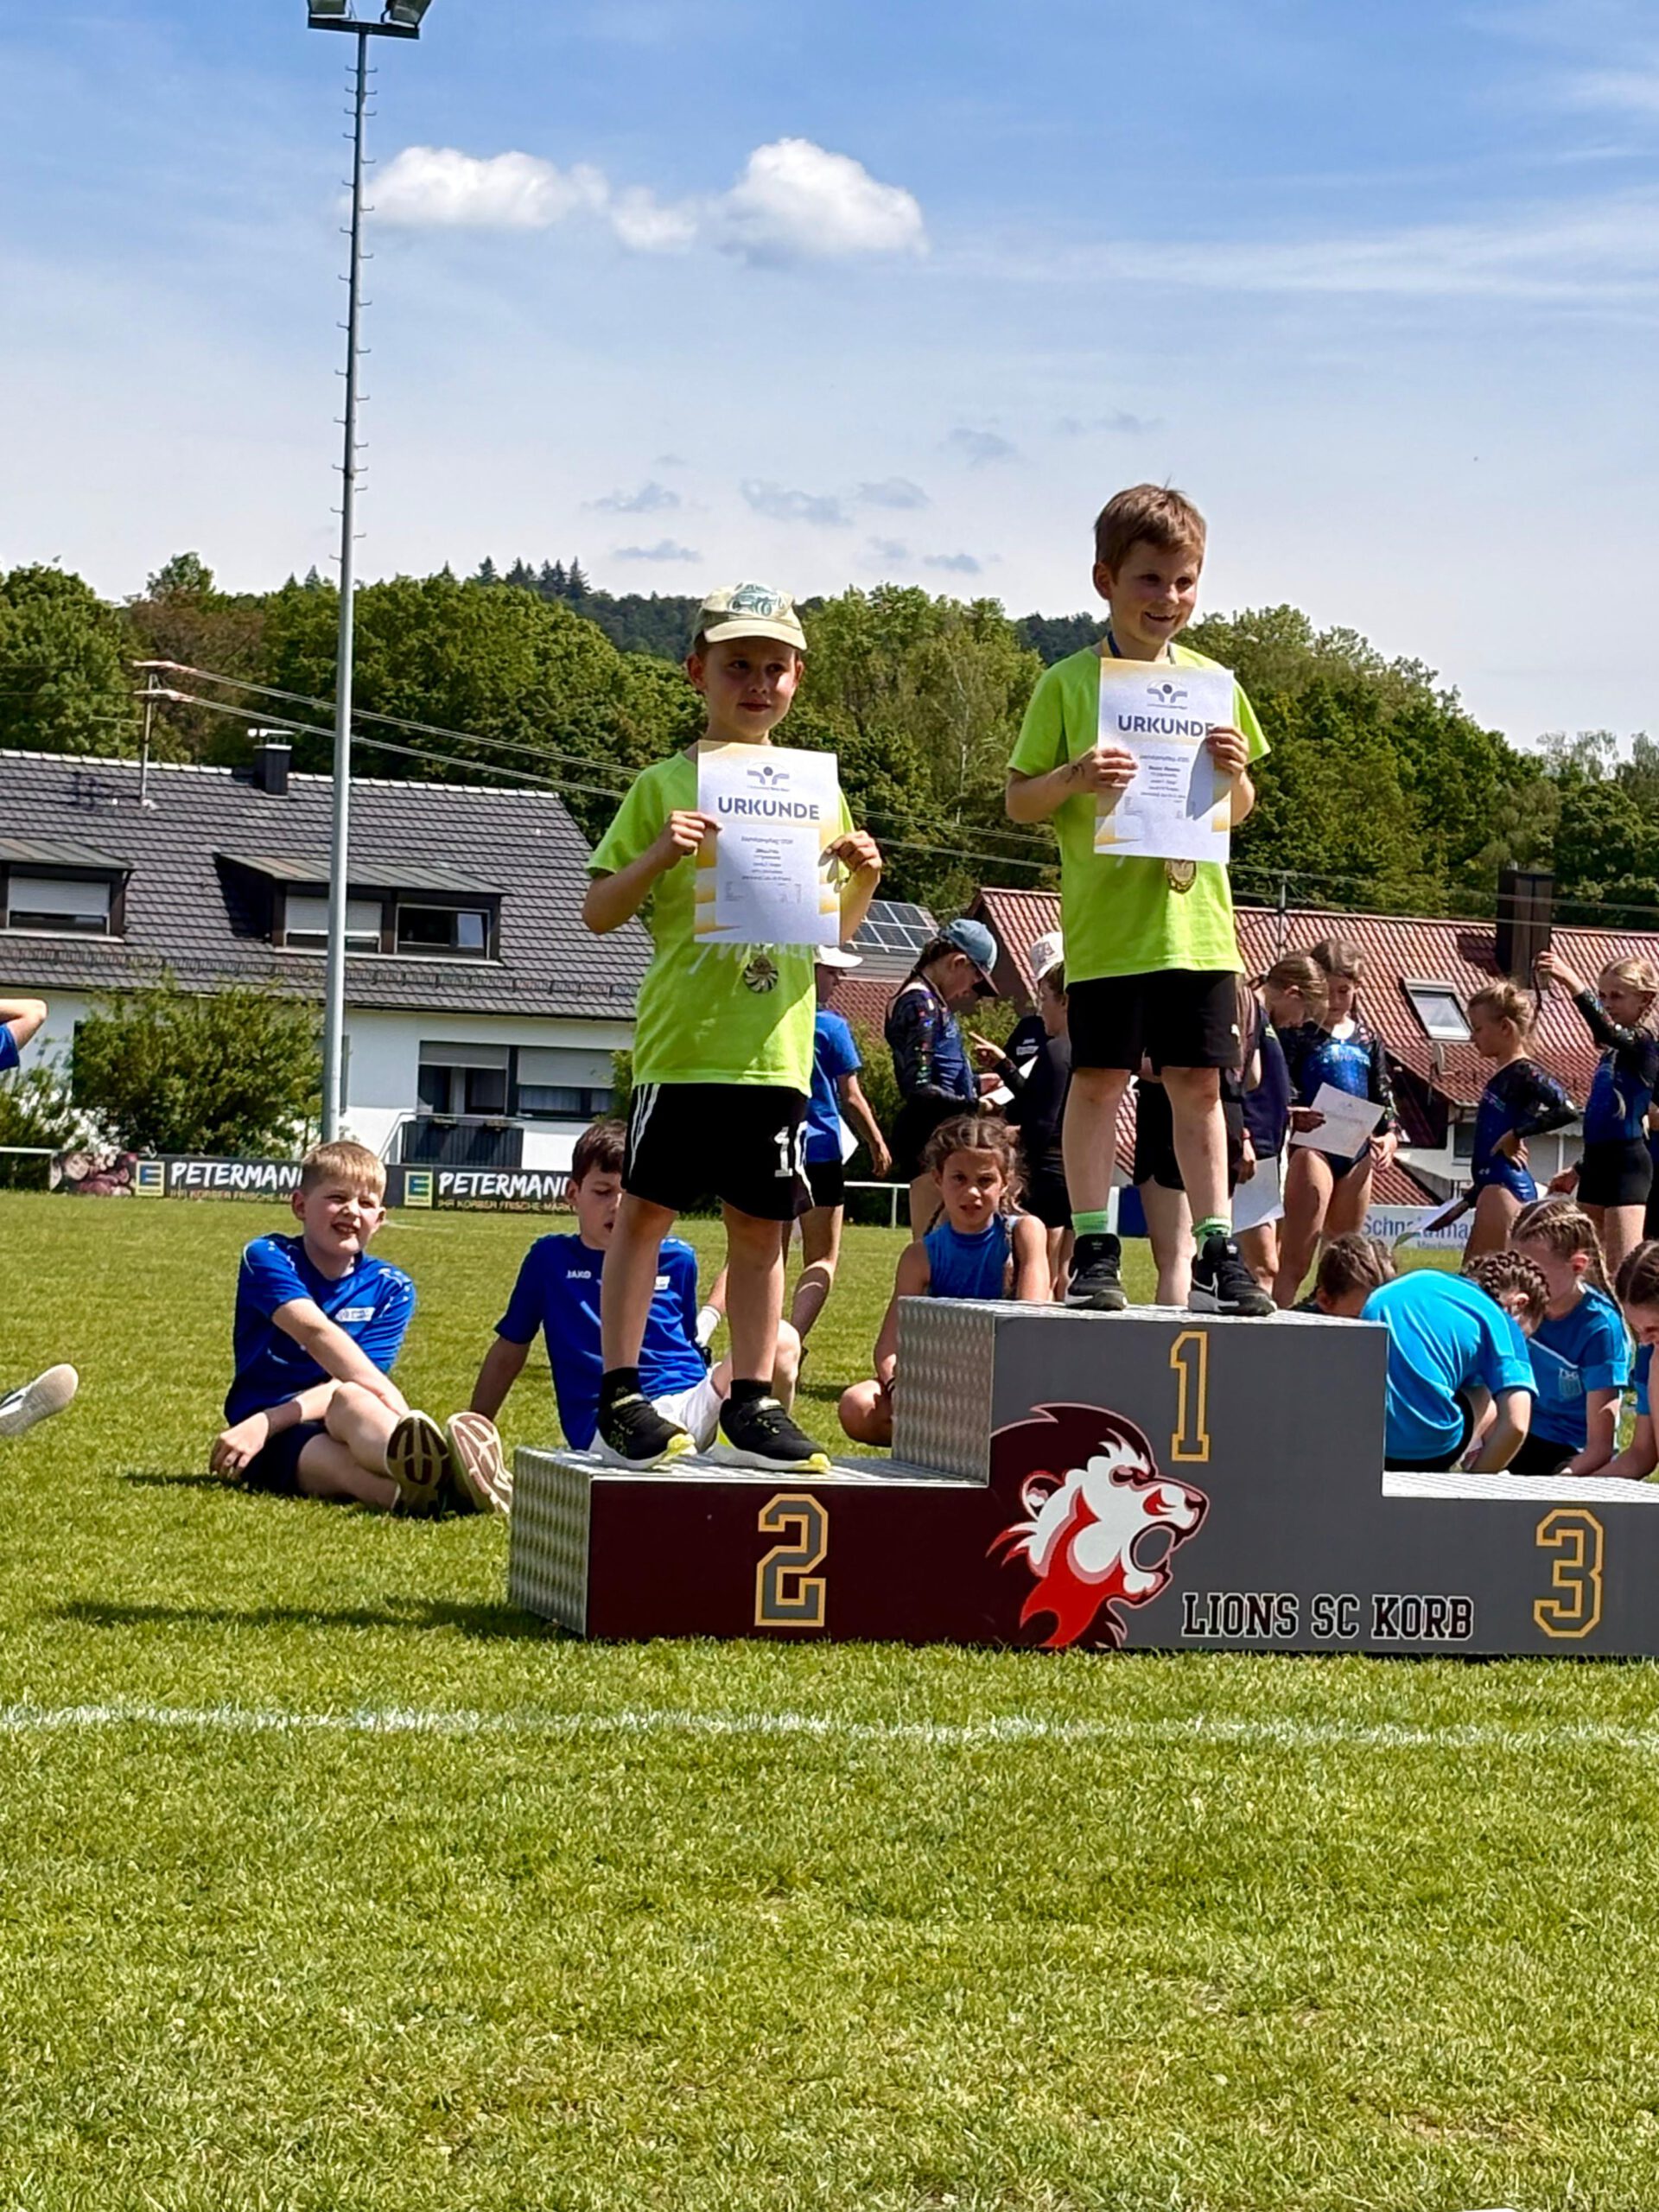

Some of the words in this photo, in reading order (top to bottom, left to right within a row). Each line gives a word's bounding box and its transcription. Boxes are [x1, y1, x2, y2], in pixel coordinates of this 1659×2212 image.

[718, 796, 820, 820] URKUNDE
[1168, 1330, 1210, 1463] 1
[754, 1493, 829, 1628] 2
[1181, 1592, 1299, 1638] LIONS
[1311, 1593, 1359, 1638] SC
[1371, 1594, 1473, 1641] KORB
[1532, 1508, 1604, 1640] 3
